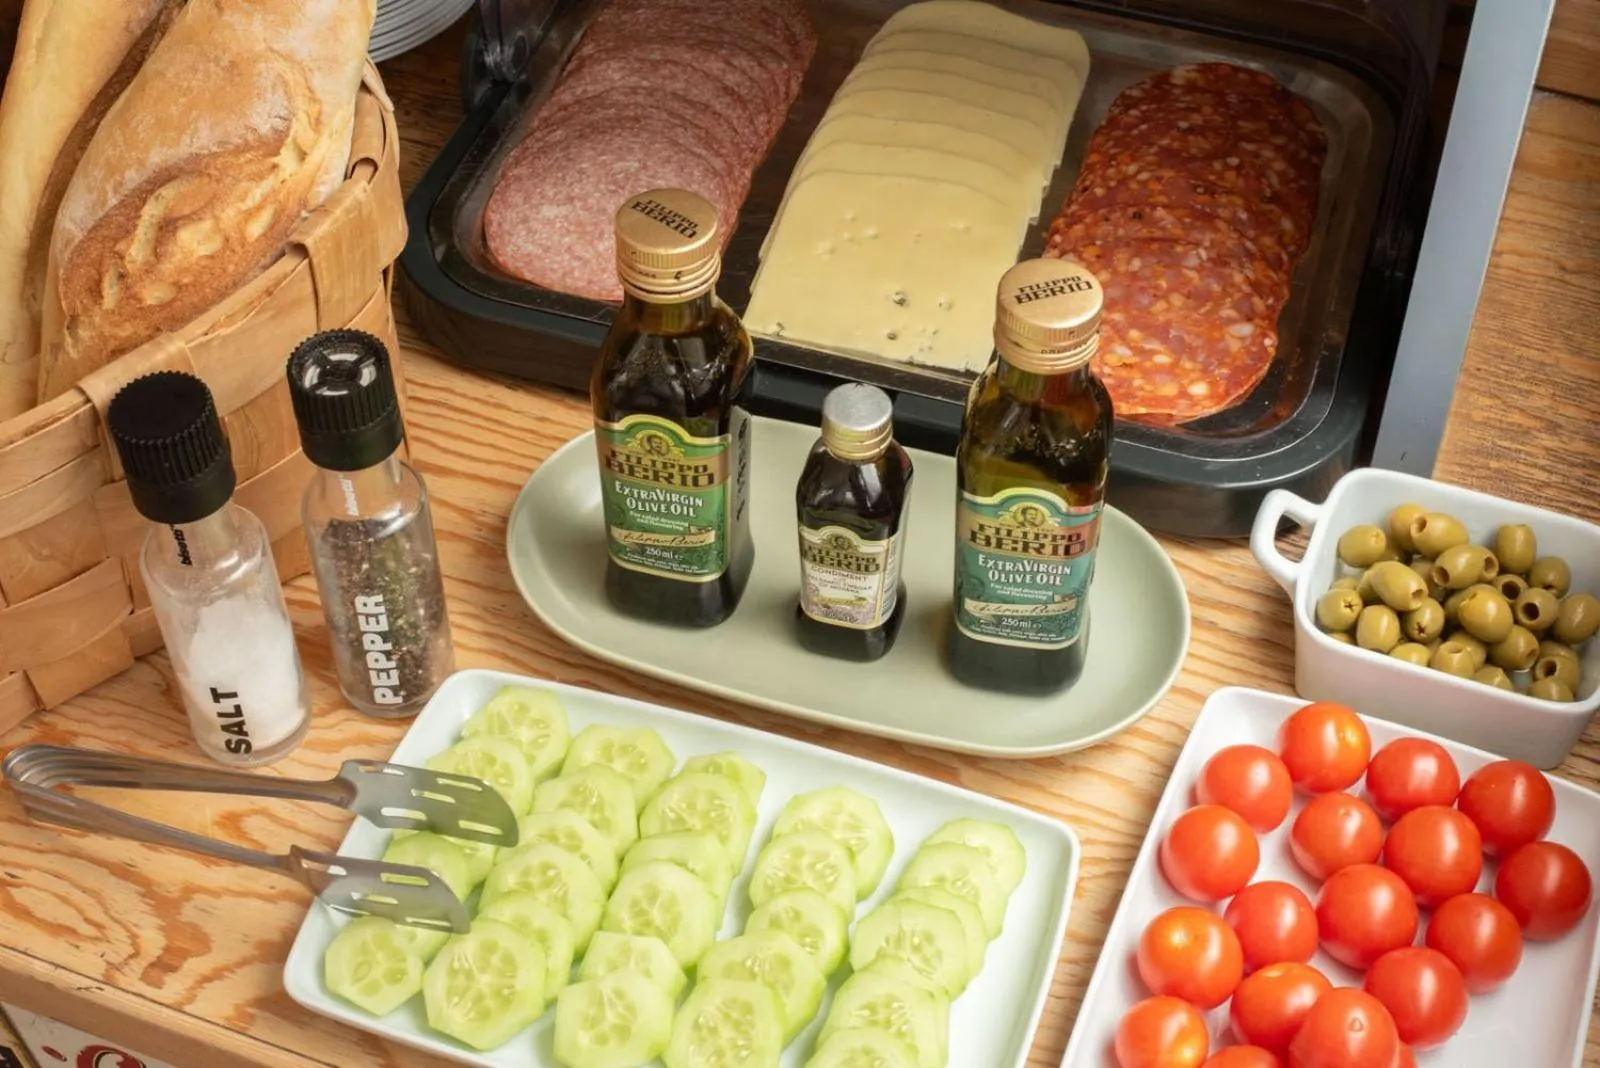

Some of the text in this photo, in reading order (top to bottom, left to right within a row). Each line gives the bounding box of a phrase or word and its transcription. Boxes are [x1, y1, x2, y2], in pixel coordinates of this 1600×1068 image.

[631, 201, 697, 239] BERIO
[645, 200, 699, 228] FILIPPO
[1013, 280, 1094, 304] BERIO
[1018, 275, 1082, 293] FILIPPO
[605, 455, 715, 487] BERIO
[610, 449, 709, 473] FILIPPO
[626, 497, 696, 517] OLIVE OIL
[969, 528, 1086, 556] BERIO
[978, 523, 1081, 542] FILIPPO
[988, 569, 1062, 586] OLIVE OIL
[1002, 617, 1031, 629] 250 ml
[355, 594, 403, 705] PEPPER
[209, 686, 253, 755] SALT
